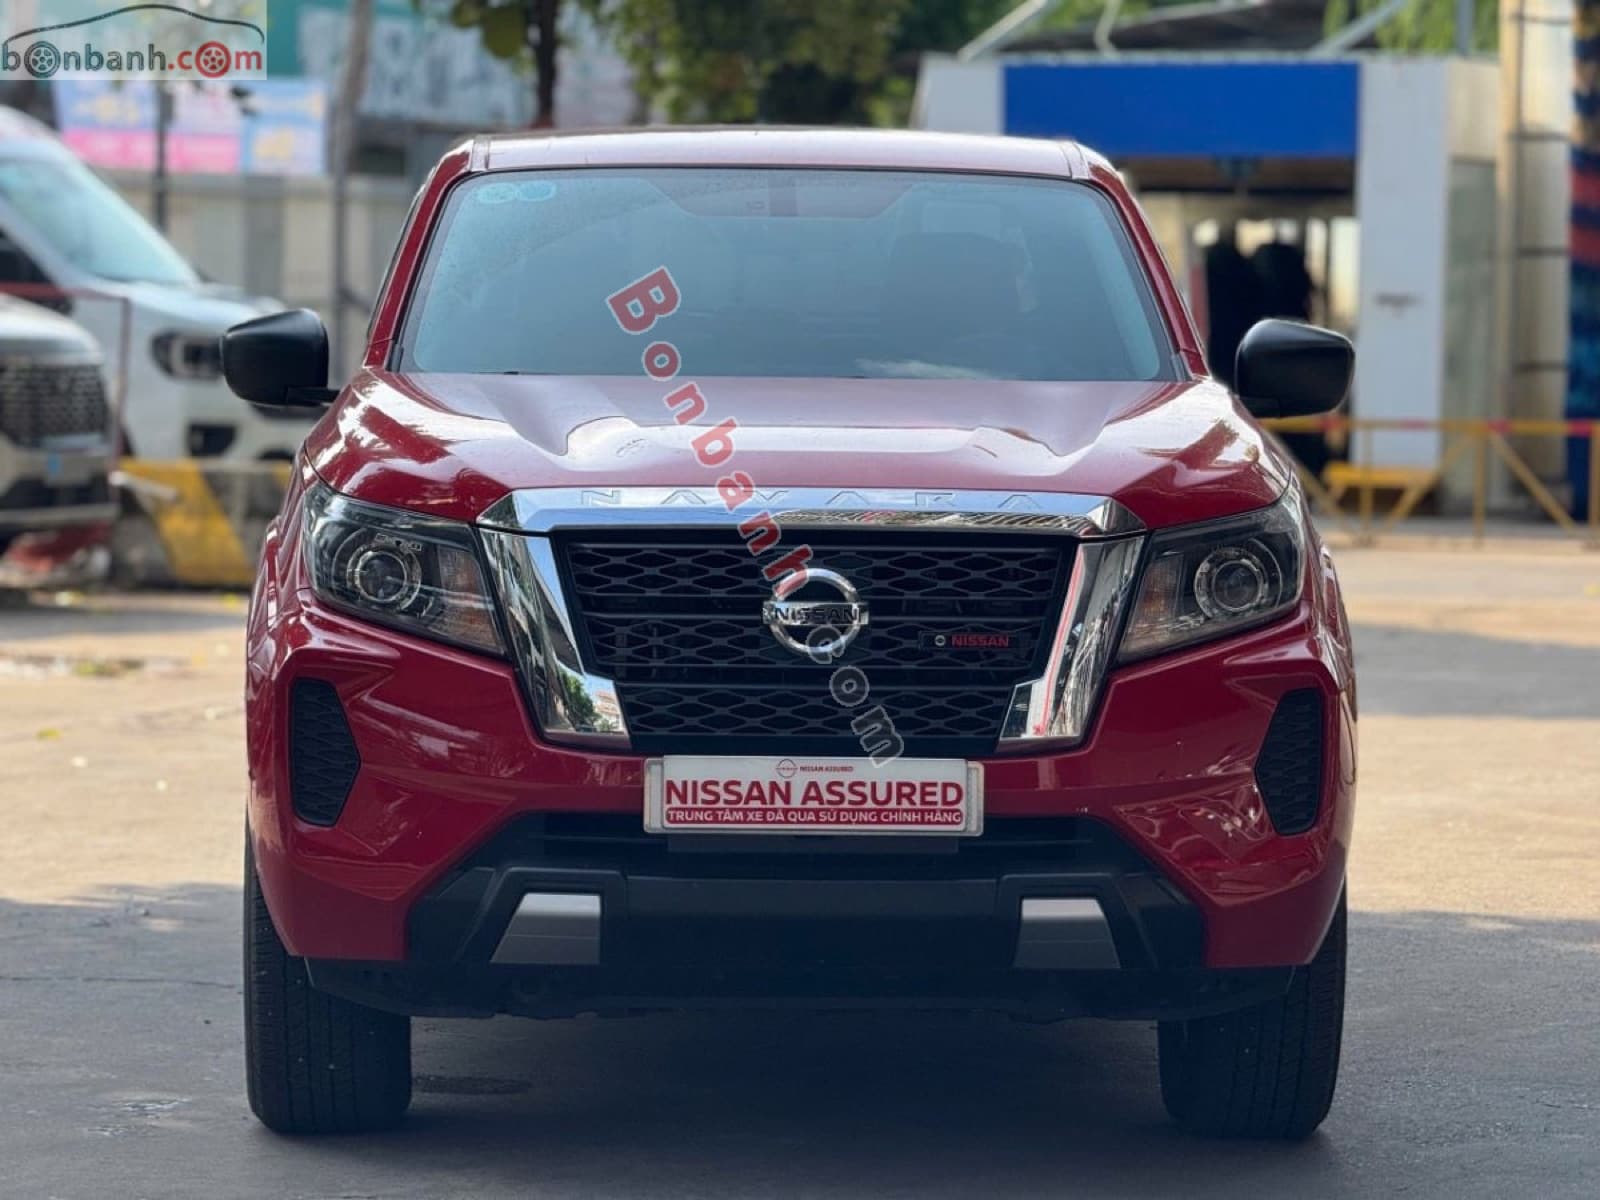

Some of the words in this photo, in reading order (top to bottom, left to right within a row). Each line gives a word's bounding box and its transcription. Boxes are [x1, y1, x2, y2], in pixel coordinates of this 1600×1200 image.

[581, 490, 1042, 509] NAVARA
[773, 607, 861, 624] NISSAN
[951, 634, 1009, 648] NISSAN
[666, 780, 791, 805] NISSAN
[801, 781, 963, 806] ASSURED
[668, 810, 713, 822] TRUNG
[716, 808, 743, 822] TÂM
[746, 810, 764, 822] XE
[787, 810, 816, 823] QUA
[840, 811, 877, 826] DỤNG
[880, 808, 922, 823] CHÍNH
[924, 808, 962, 823] HÀNG
